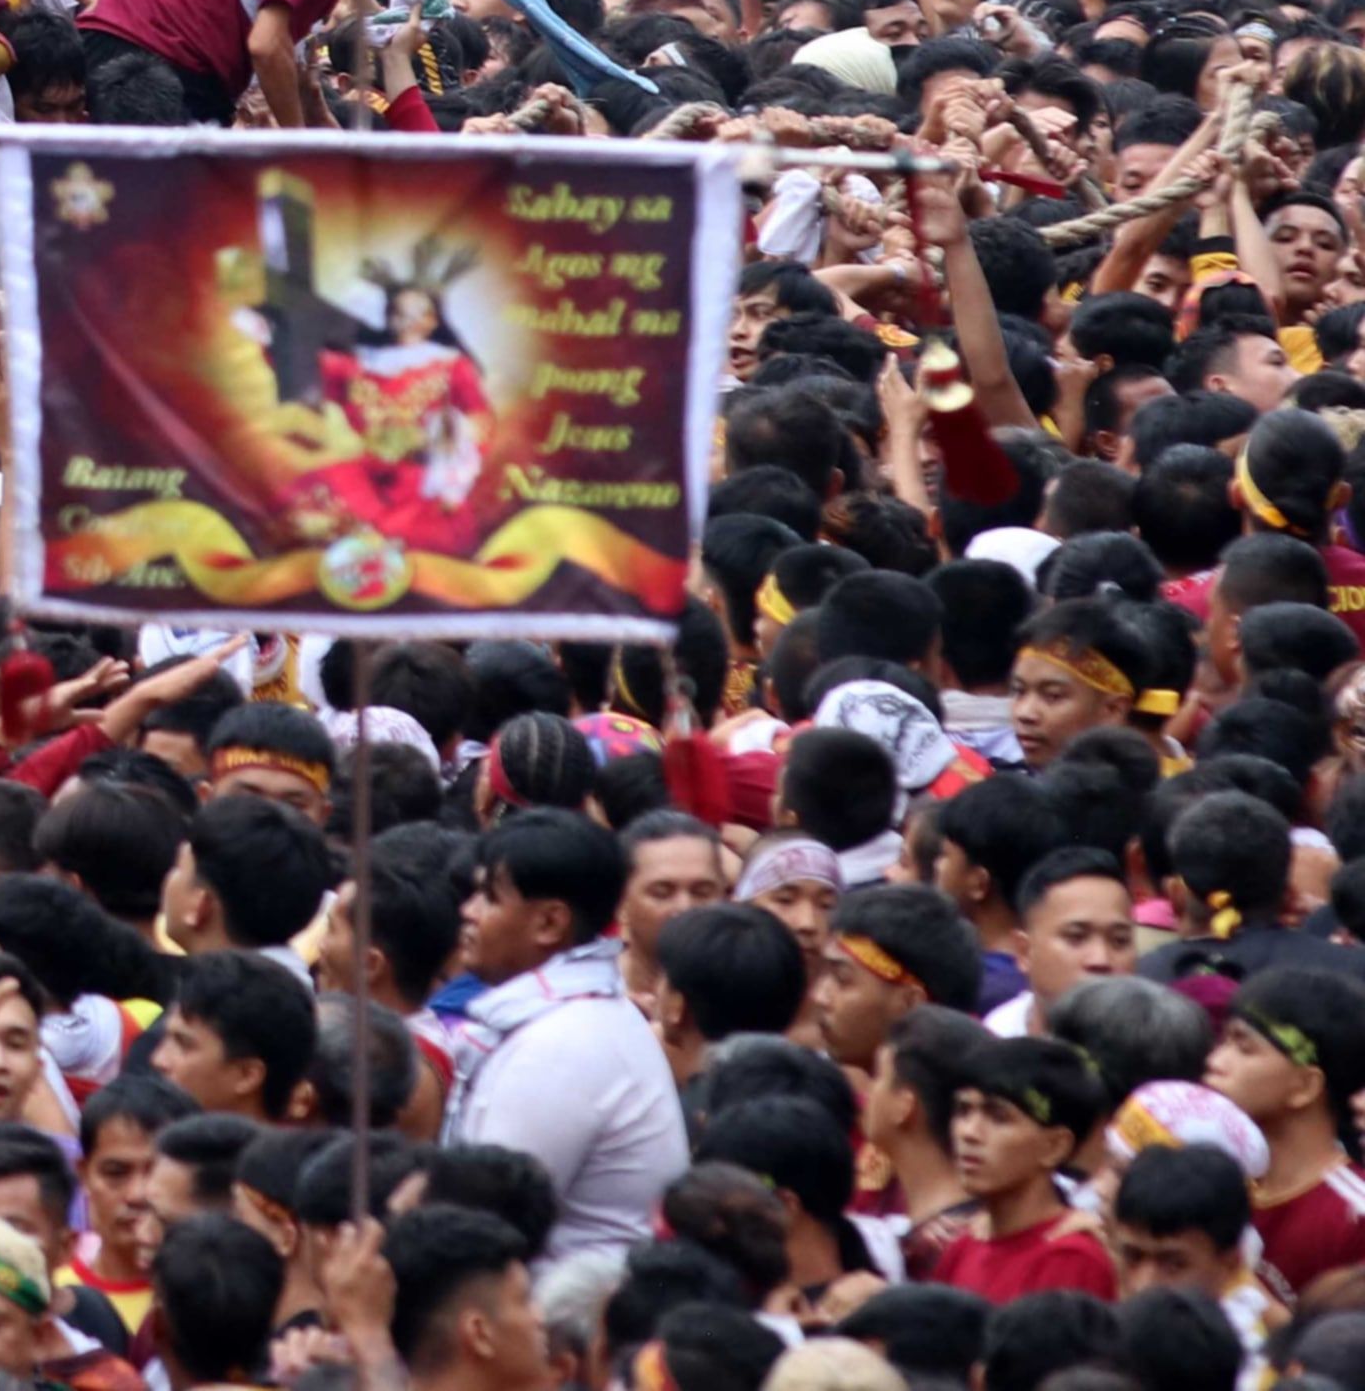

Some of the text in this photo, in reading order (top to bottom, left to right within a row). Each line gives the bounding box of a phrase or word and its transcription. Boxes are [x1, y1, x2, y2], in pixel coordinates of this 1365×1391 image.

[628, 196, 674, 221] sa
[607, 251, 666, 290] ng
[631, 310, 681, 336] na
